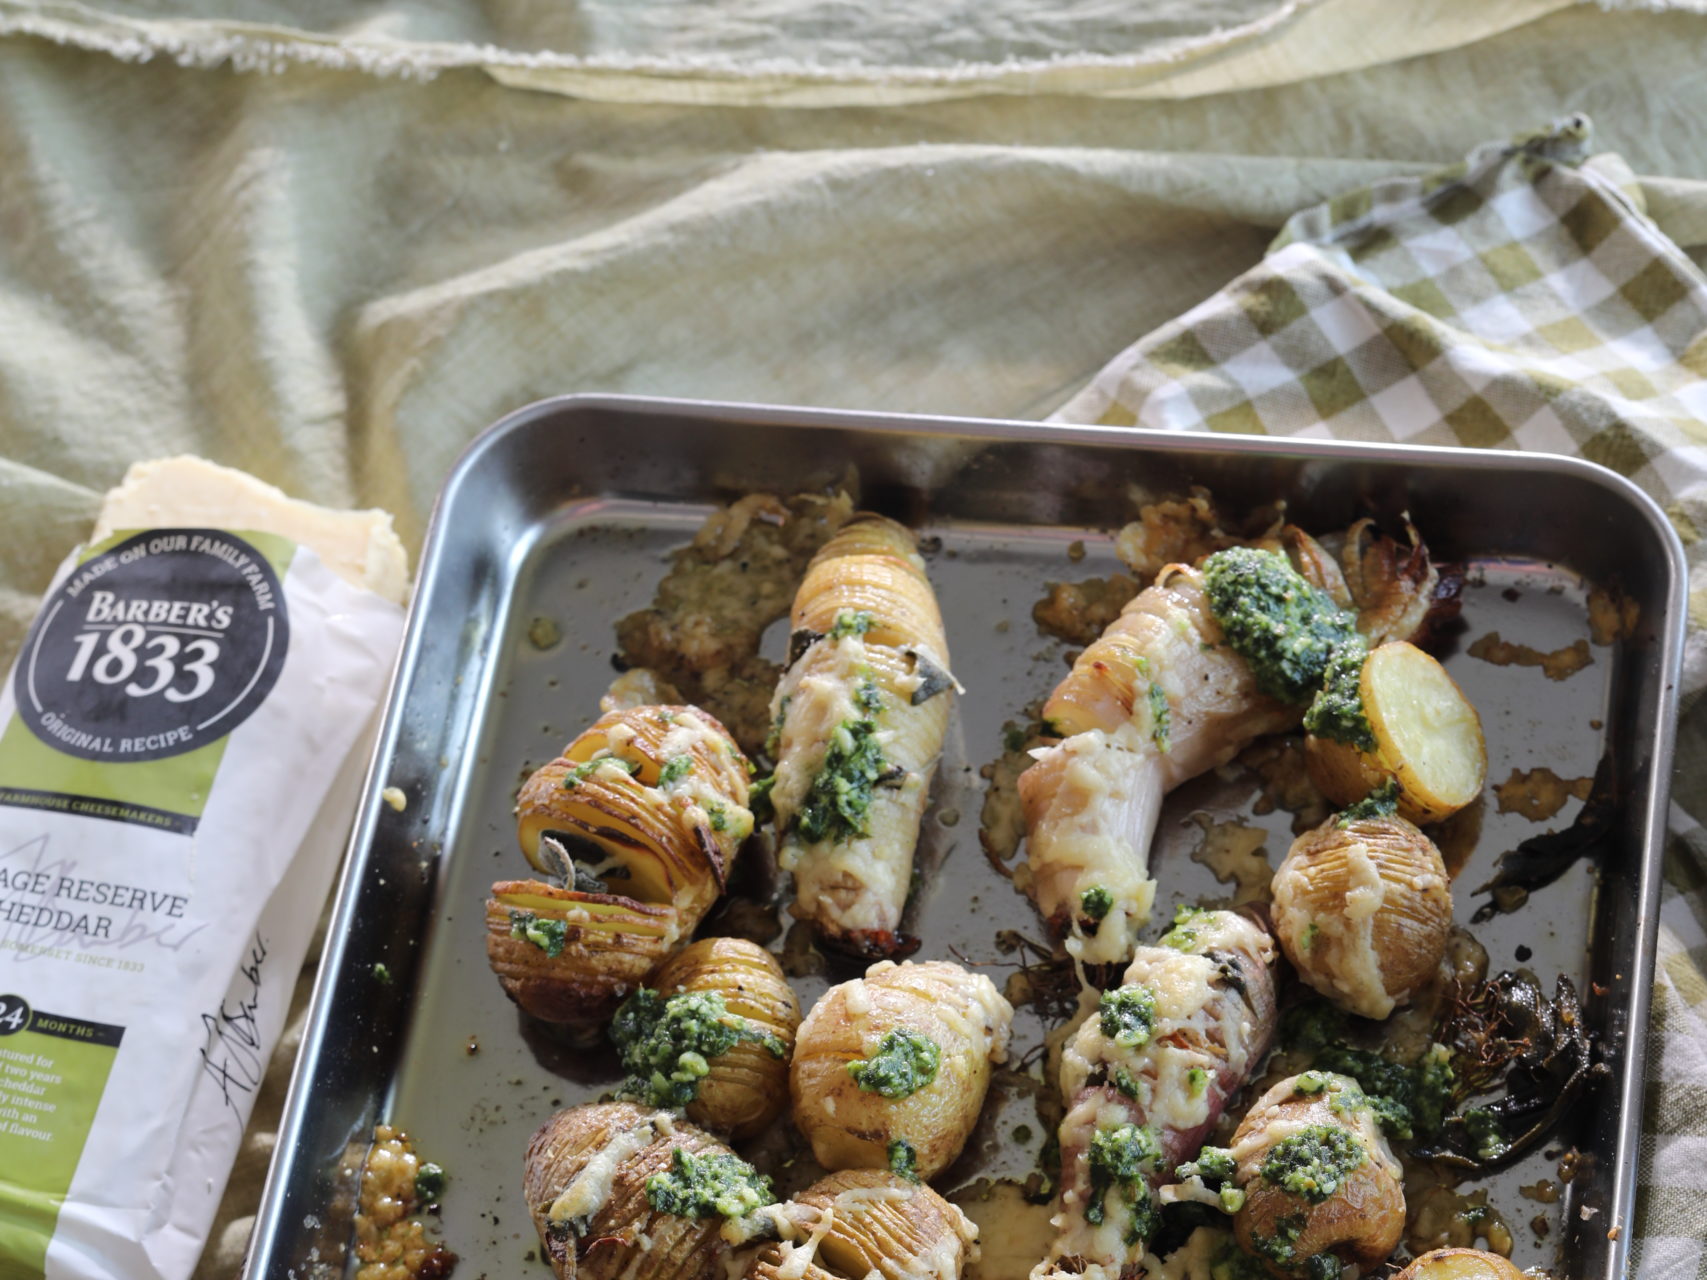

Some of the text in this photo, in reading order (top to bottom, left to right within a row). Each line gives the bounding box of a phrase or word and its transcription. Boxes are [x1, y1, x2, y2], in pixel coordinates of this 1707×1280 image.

[66, 534, 275, 611] MADE ON OUR FAMILY FARM
[85, 590, 234, 630] BARBER'S
[66, 623, 220, 703] 1833
[40, 711, 193, 753] ORIGINAL RECIPE
[71, 801, 173, 826] CHEESEMAKERS
[53, 876, 189, 918] RESERVE
[75, 952, 114, 970] SINCE
[37, 1017, 95, 1037] MONTHS
[29, 1069, 62, 1085] years
[11, 1094, 57, 1112] intense
